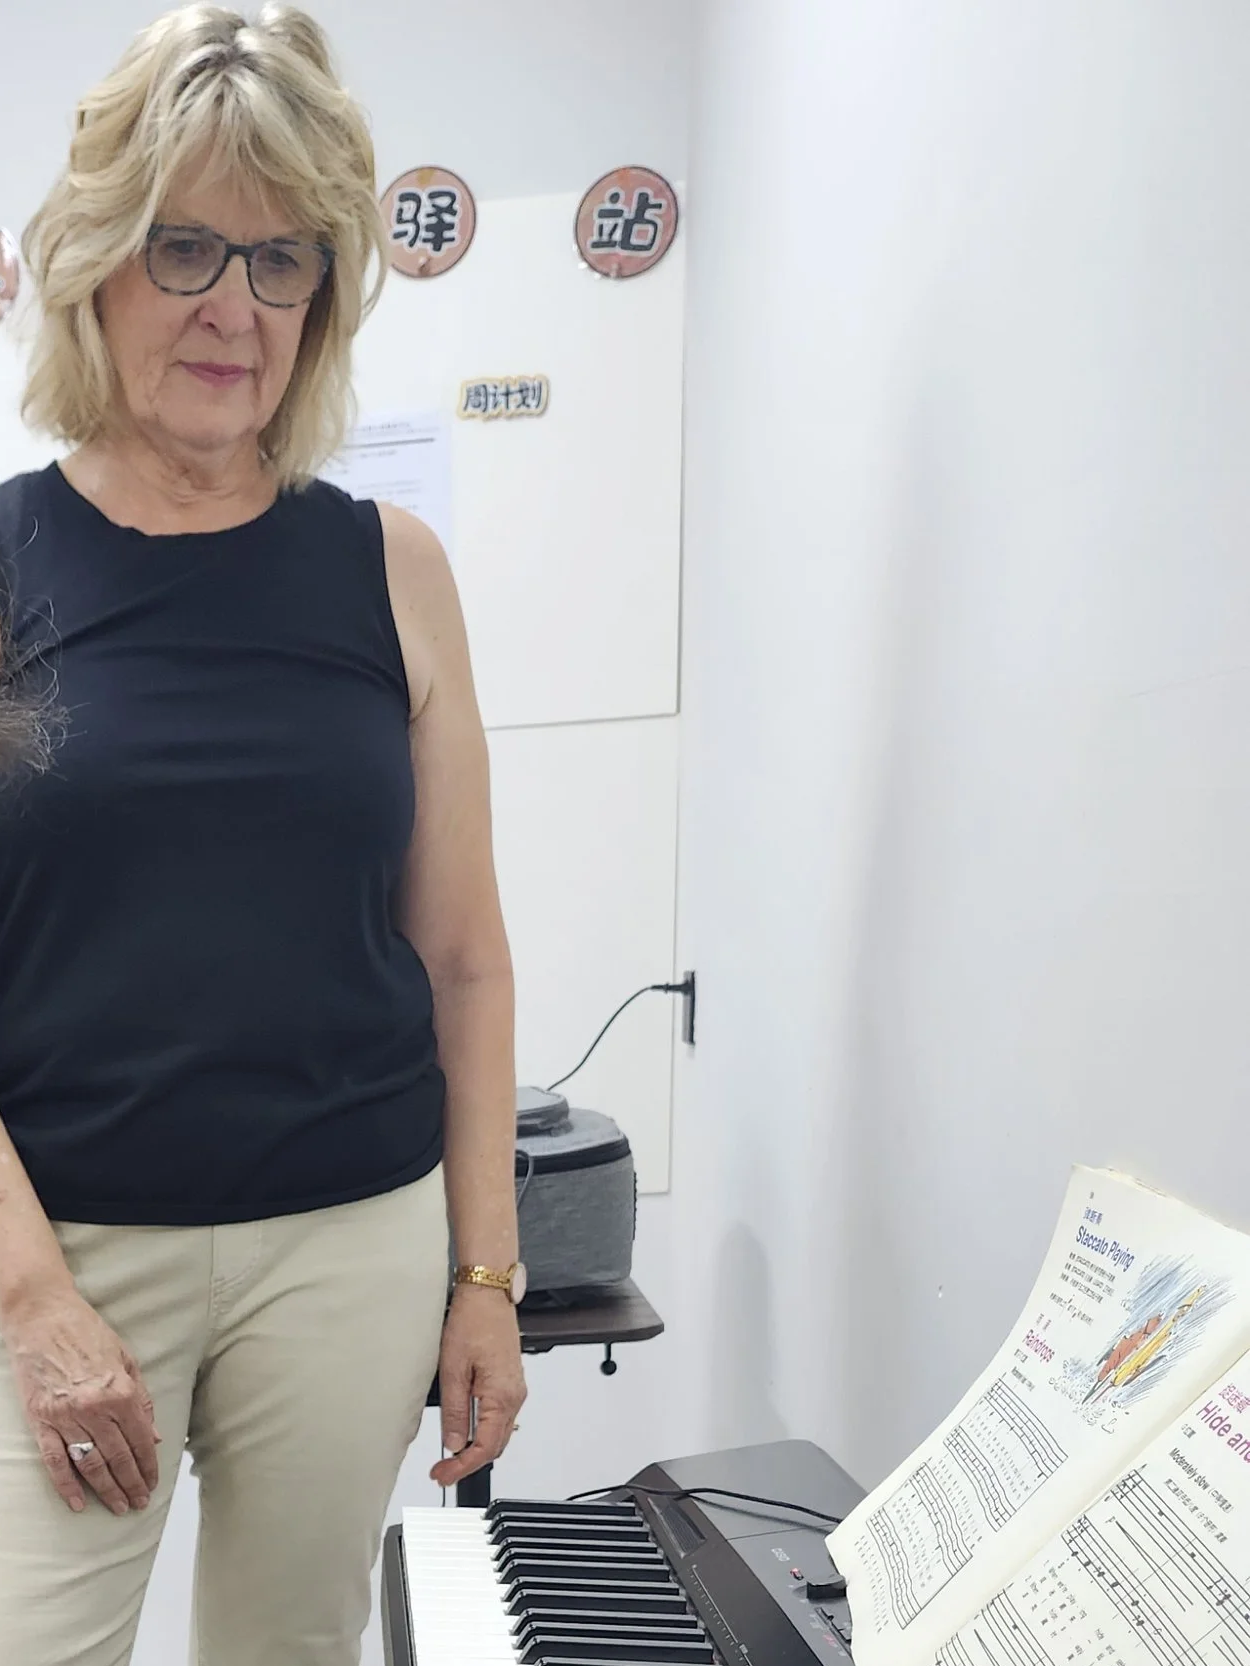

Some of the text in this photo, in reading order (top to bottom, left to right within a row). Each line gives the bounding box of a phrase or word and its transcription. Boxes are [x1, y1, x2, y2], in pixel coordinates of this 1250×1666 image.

[391, 191, 457, 251] 驿
[592, 194, 659, 251] 站
[461, 379, 544, 415] 周计划
[1076, 1225, 1108, 1255] Staccato
[1106, 1241, 1135, 1272] Playing
[1196, 1400, 1232, 1437] Hide
[1168, 1447, 1198, 1480] Moderately
[1193, 1475, 1210, 1496] slow
